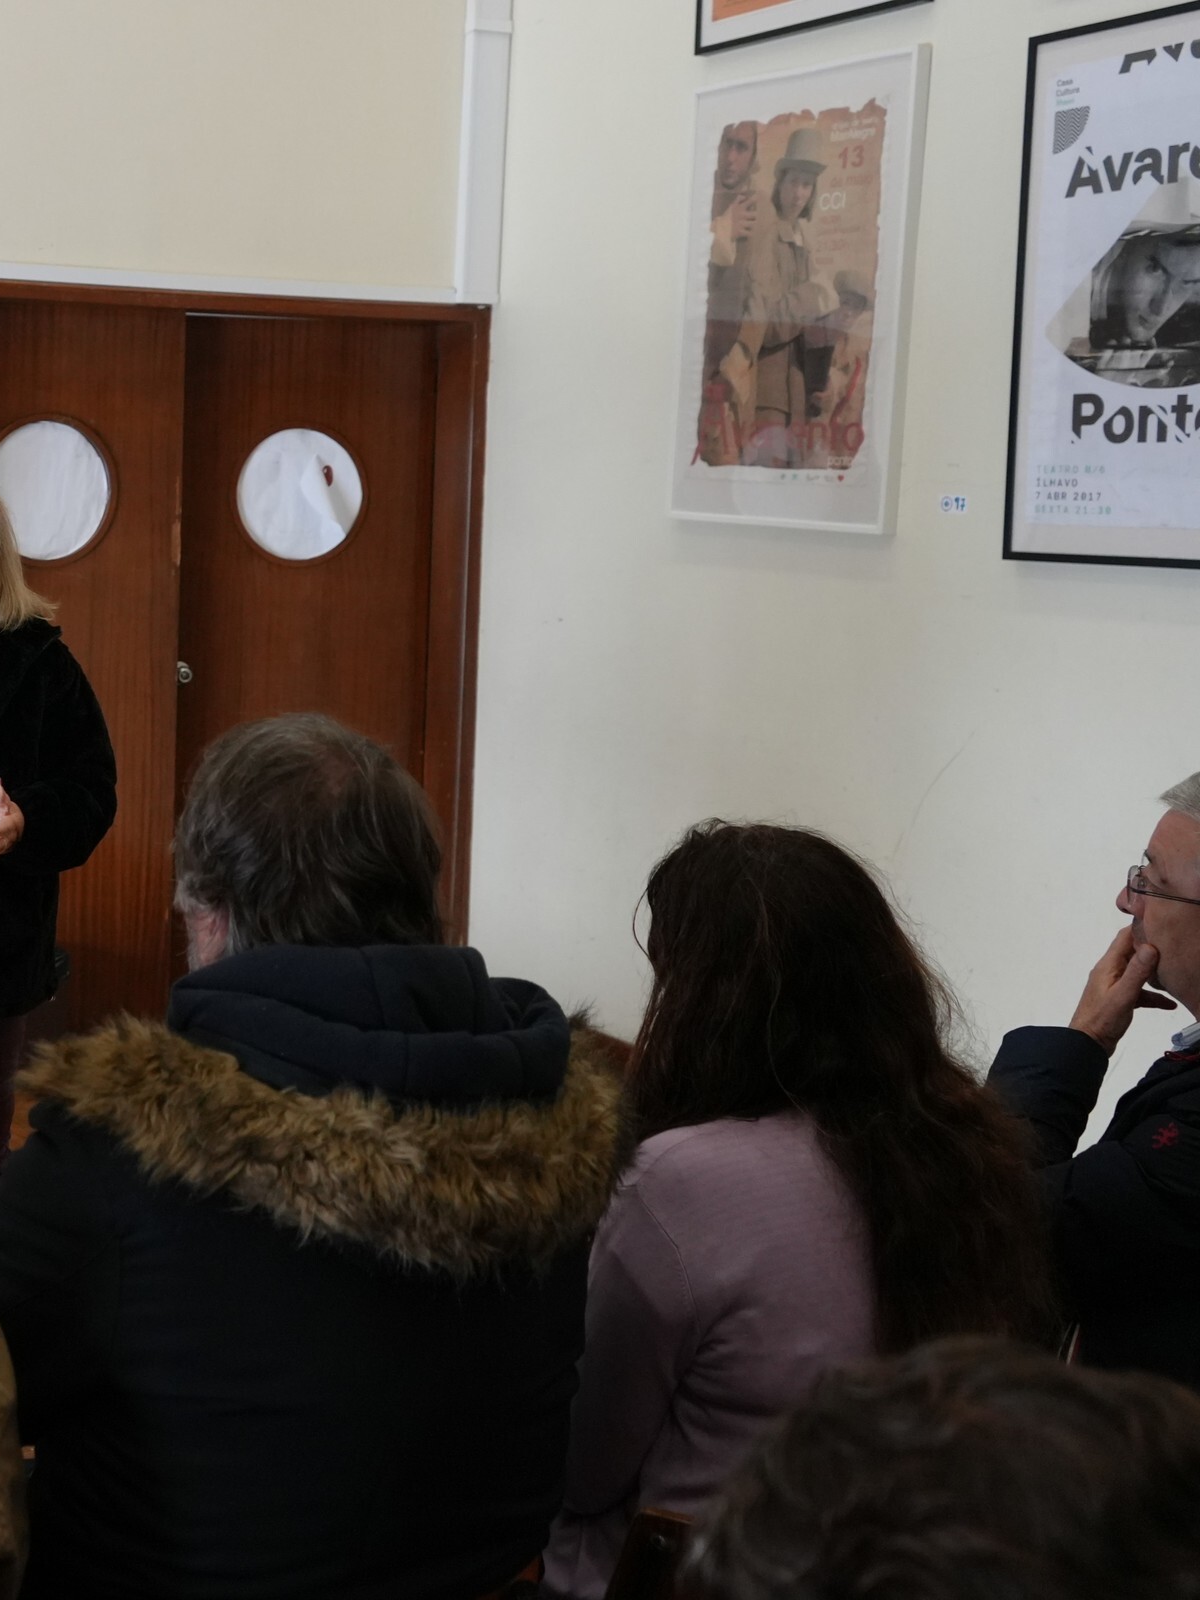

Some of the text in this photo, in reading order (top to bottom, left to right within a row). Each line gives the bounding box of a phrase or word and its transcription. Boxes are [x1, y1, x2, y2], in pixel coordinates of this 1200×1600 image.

[838, 145, 865, 169] 13
[1071, 393, 1200, 444] Pont
[1037, 465, 1079, 474] TEATRO
[1035, 491, 1102, 502] 7 ABR 2017
